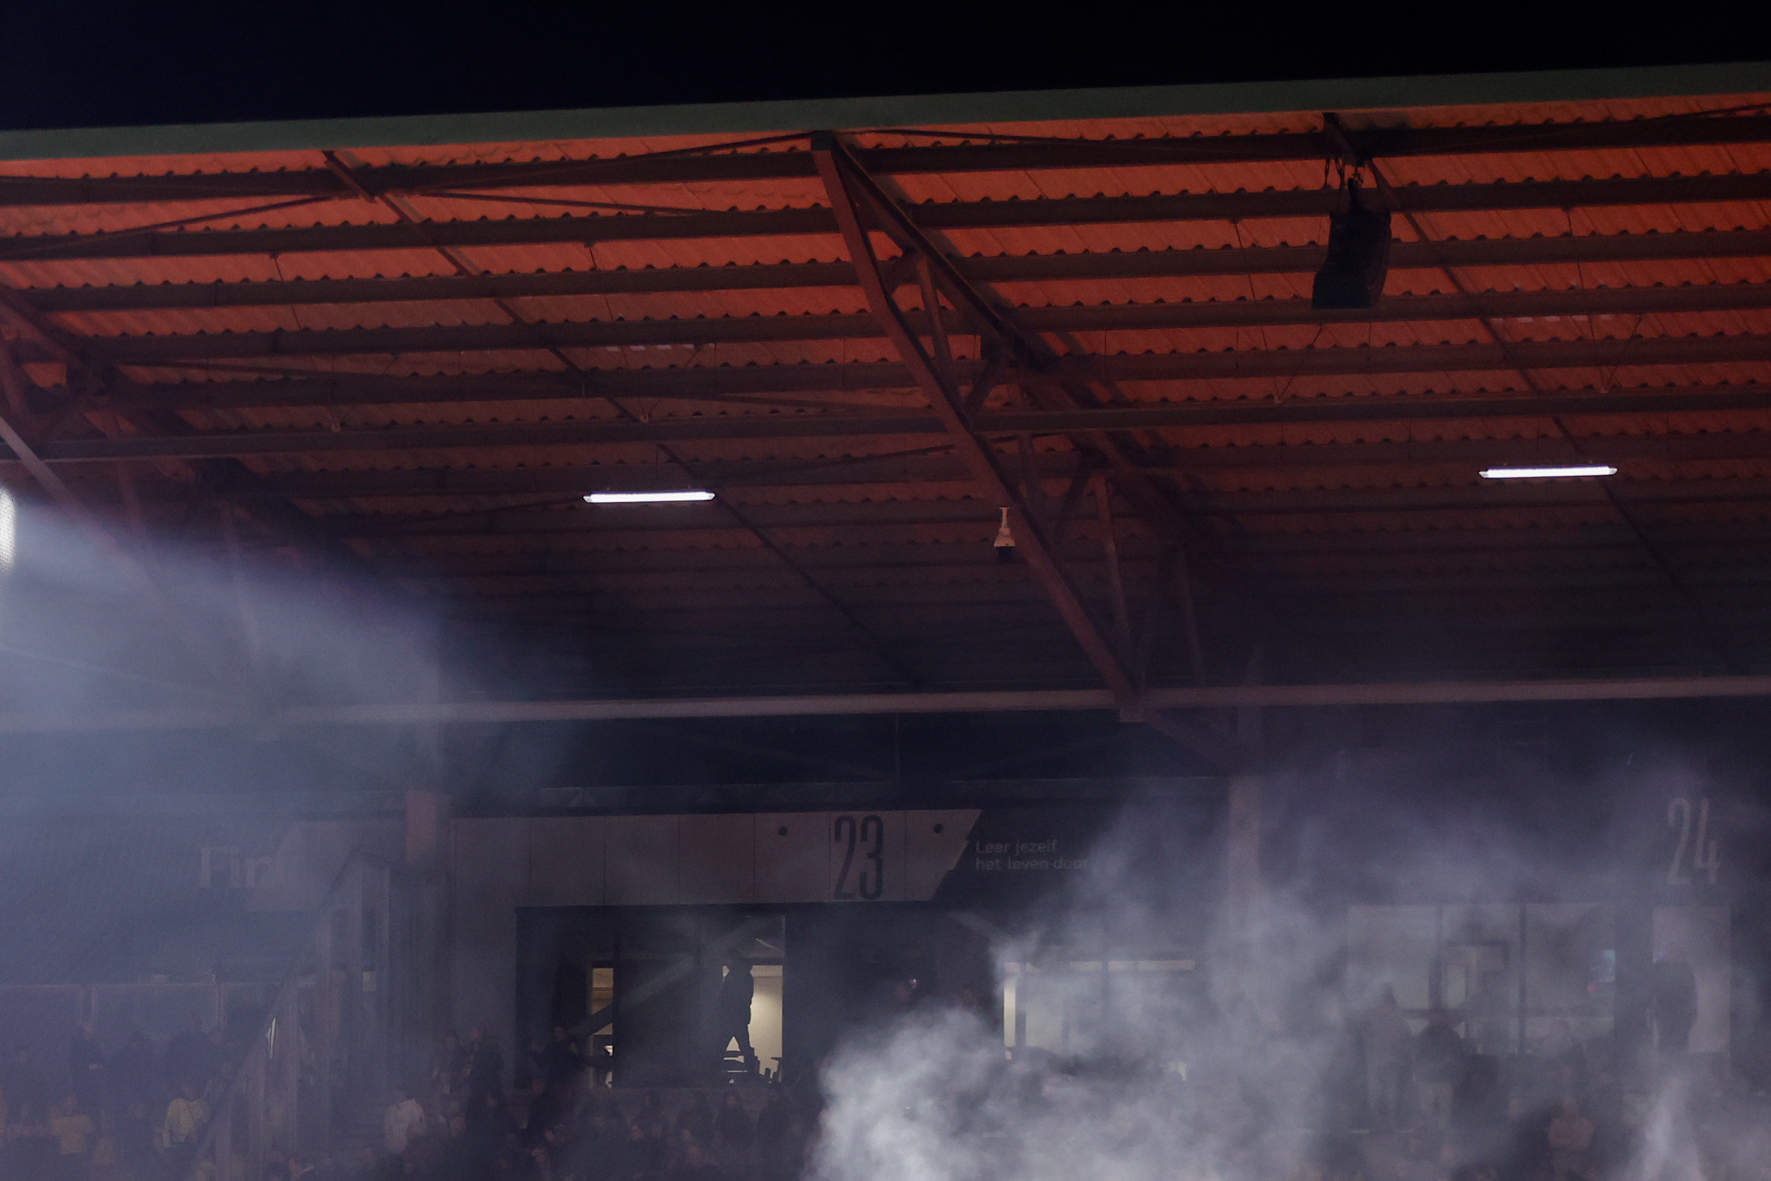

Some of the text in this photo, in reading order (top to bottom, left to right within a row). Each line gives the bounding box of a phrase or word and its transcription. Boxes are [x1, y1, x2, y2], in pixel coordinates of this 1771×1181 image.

[833, 814, 884, 900] 23
[975, 838, 1058, 858] Leer jezelf
[975, 857, 1002, 871] het
[1007, 857, 1049, 871] leven
[1667, 797, 1720, 885] 24
